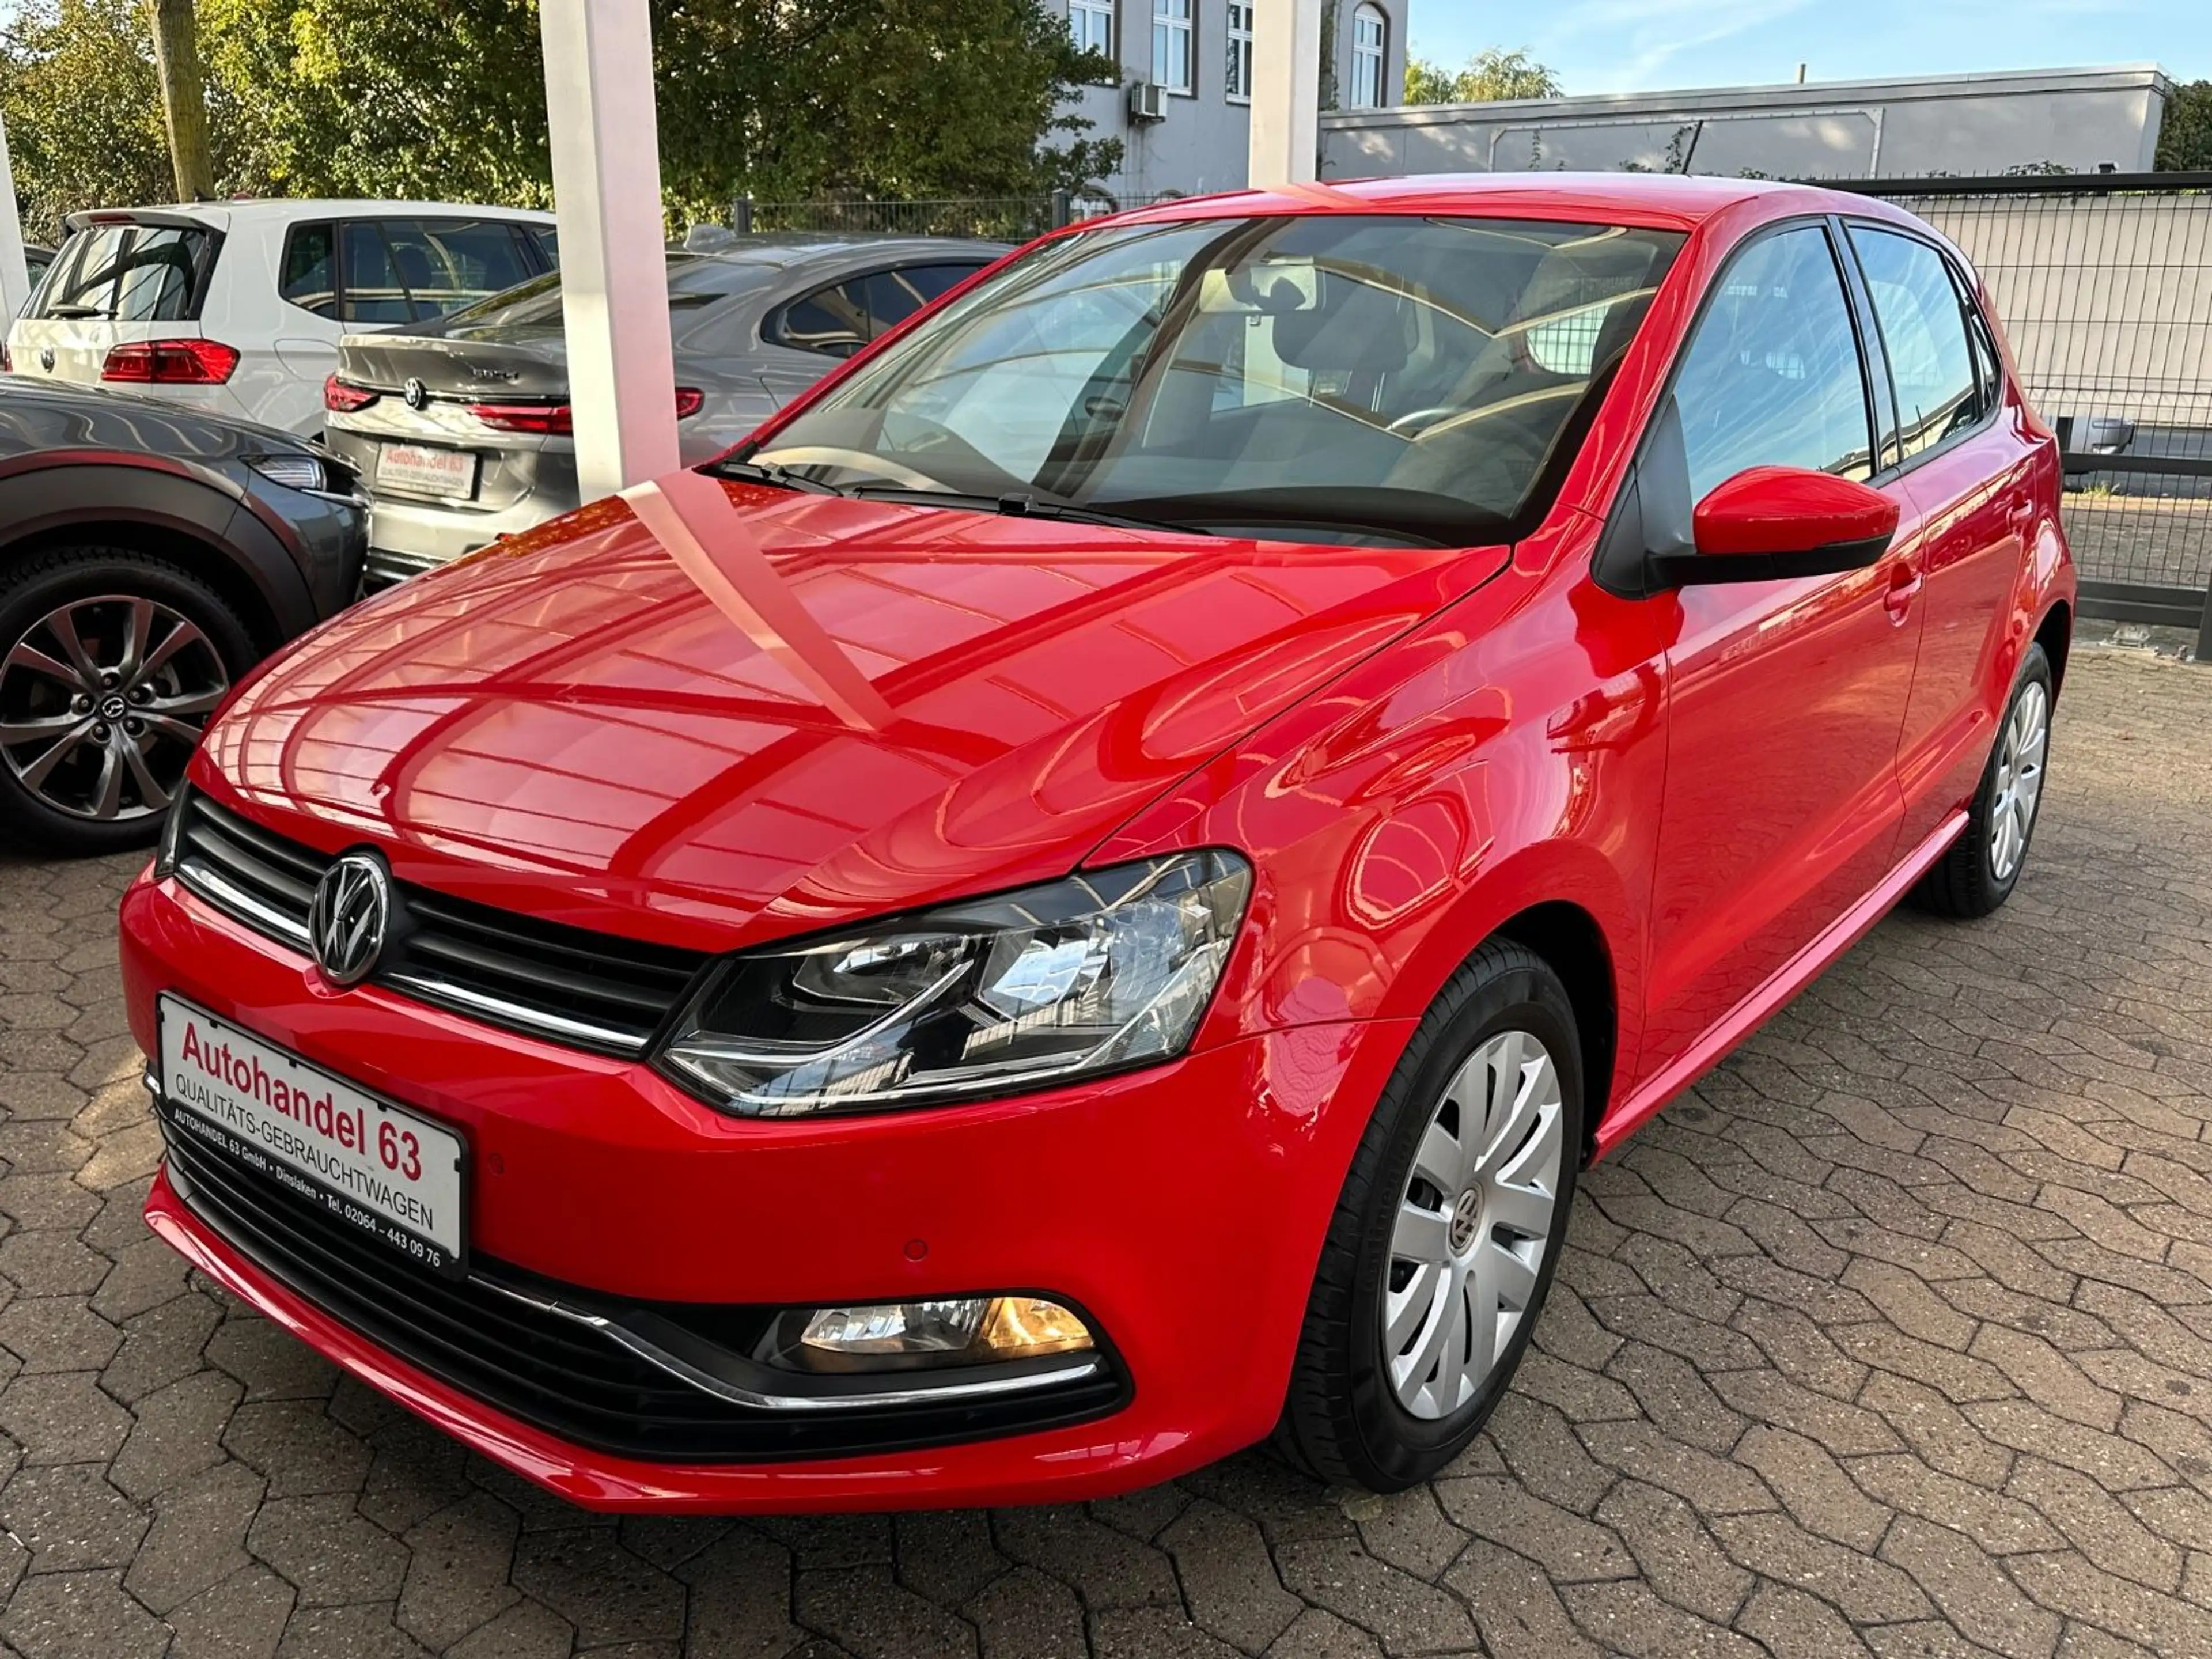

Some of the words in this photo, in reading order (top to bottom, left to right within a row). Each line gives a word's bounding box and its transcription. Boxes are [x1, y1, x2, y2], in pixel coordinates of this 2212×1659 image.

[176, 1073, 433, 1232] QUALITÄTS-GEBRAUCHTWAGEN
[182, 1021, 365, 1156] Autohandel
[378, 1120, 422, 1181] 63
[174, 1108, 229, 1149] AUTOHANDEL
[229, 1138, 241, 1156] 63
[241, 1146, 267, 1171] GmbH
[276, 1165, 317, 1200] Dinslaken
[327, 1193, 343, 1214] Tel.
[345, 1204, 376, 1232] 02064
[387, 1227, 407, 1249] 443
[410, 1239, 423, 1258] 09
[427, 1248, 441, 1267] 76
